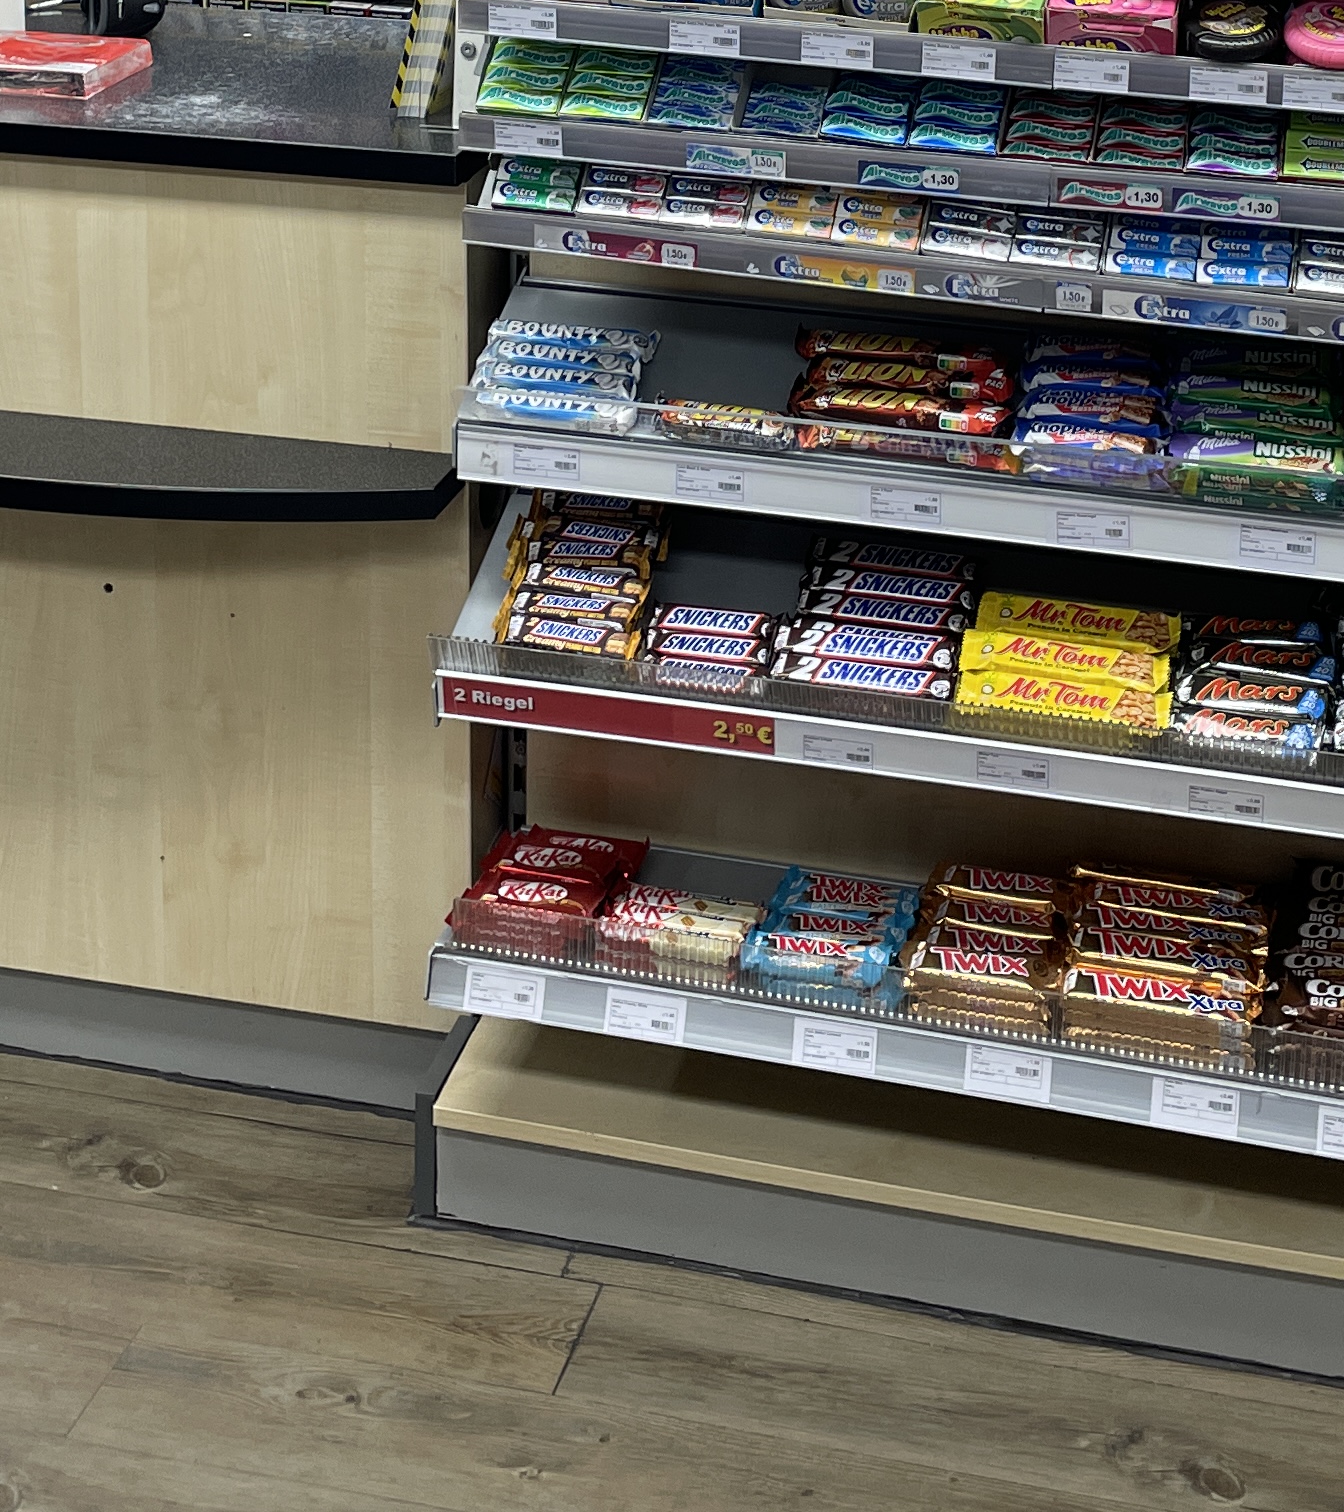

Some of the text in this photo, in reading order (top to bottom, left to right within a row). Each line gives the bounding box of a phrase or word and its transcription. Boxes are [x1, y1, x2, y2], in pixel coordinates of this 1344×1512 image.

[479, 87, 553, 107] Airwaves
[862, 165, 920, 184] Airwaves
[507, 319, 605, 344] BOUNTY
[830, 329, 917, 353] LION
[1198, 436, 1241, 451] Milka
[854, 572, 956, 601] SNICKERS
[665, 607, 759, 632] SNICKERS
[820, 660, 926, 692] SNICKERS
[453, 688, 536, 712] 2 Riegel
[1049, 681, 1113, 710] Tom
[1195, 677, 1302, 702] Mars
[506, 882, 565, 901] KitKat
[1188, 994, 1243, 1013] Xtra
[1309, 995, 1339, 1008] BIG
